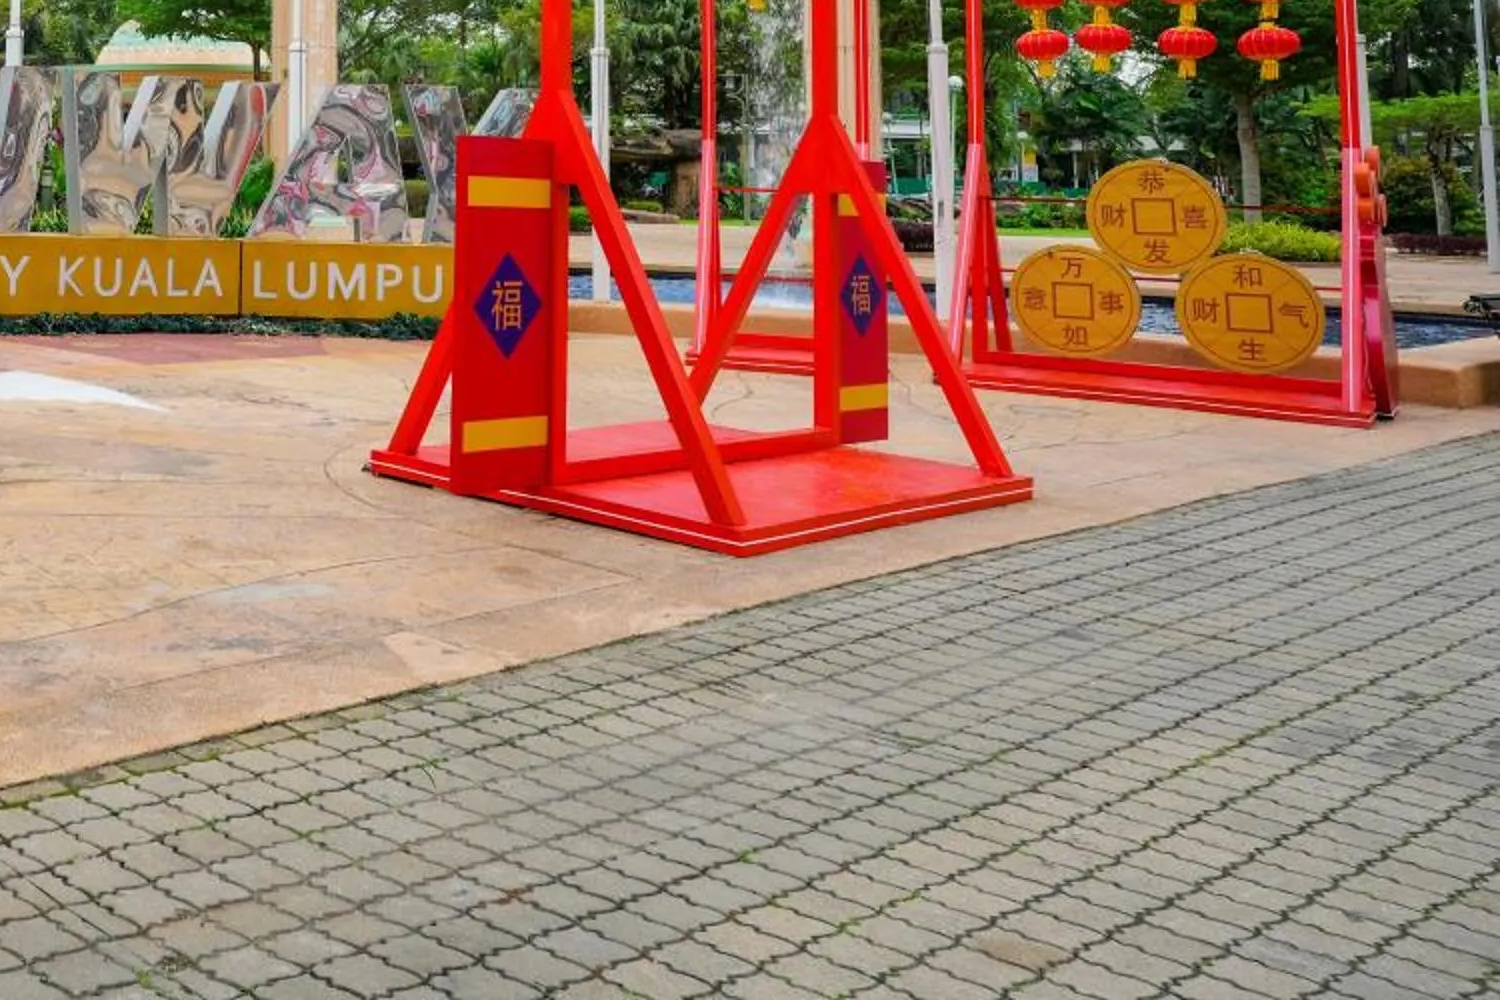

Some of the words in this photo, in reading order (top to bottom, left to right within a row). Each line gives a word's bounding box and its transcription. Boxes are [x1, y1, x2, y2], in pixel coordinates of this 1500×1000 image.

[57, 256, 224, 298] KUALA
[252, 260, 445, 303] LUMPU
[851, 274, 872, 316] 福
[491, 279, 523, 332] 福
